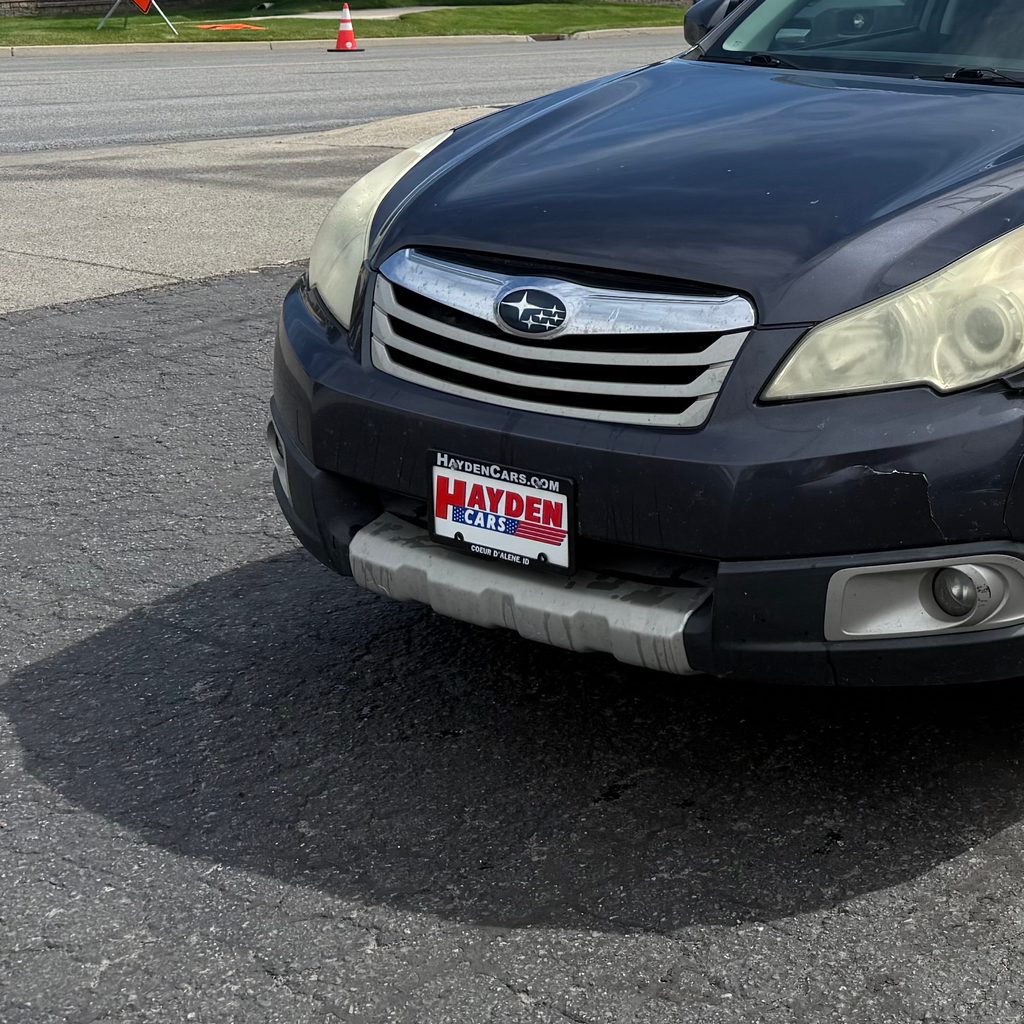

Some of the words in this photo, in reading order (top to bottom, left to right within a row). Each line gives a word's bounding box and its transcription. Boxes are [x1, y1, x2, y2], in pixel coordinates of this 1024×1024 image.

[435, 474, 564, 529] HAYDEN
[463, 508, 507, 533] CARS
[470, 544, 492, 556] COEUR
